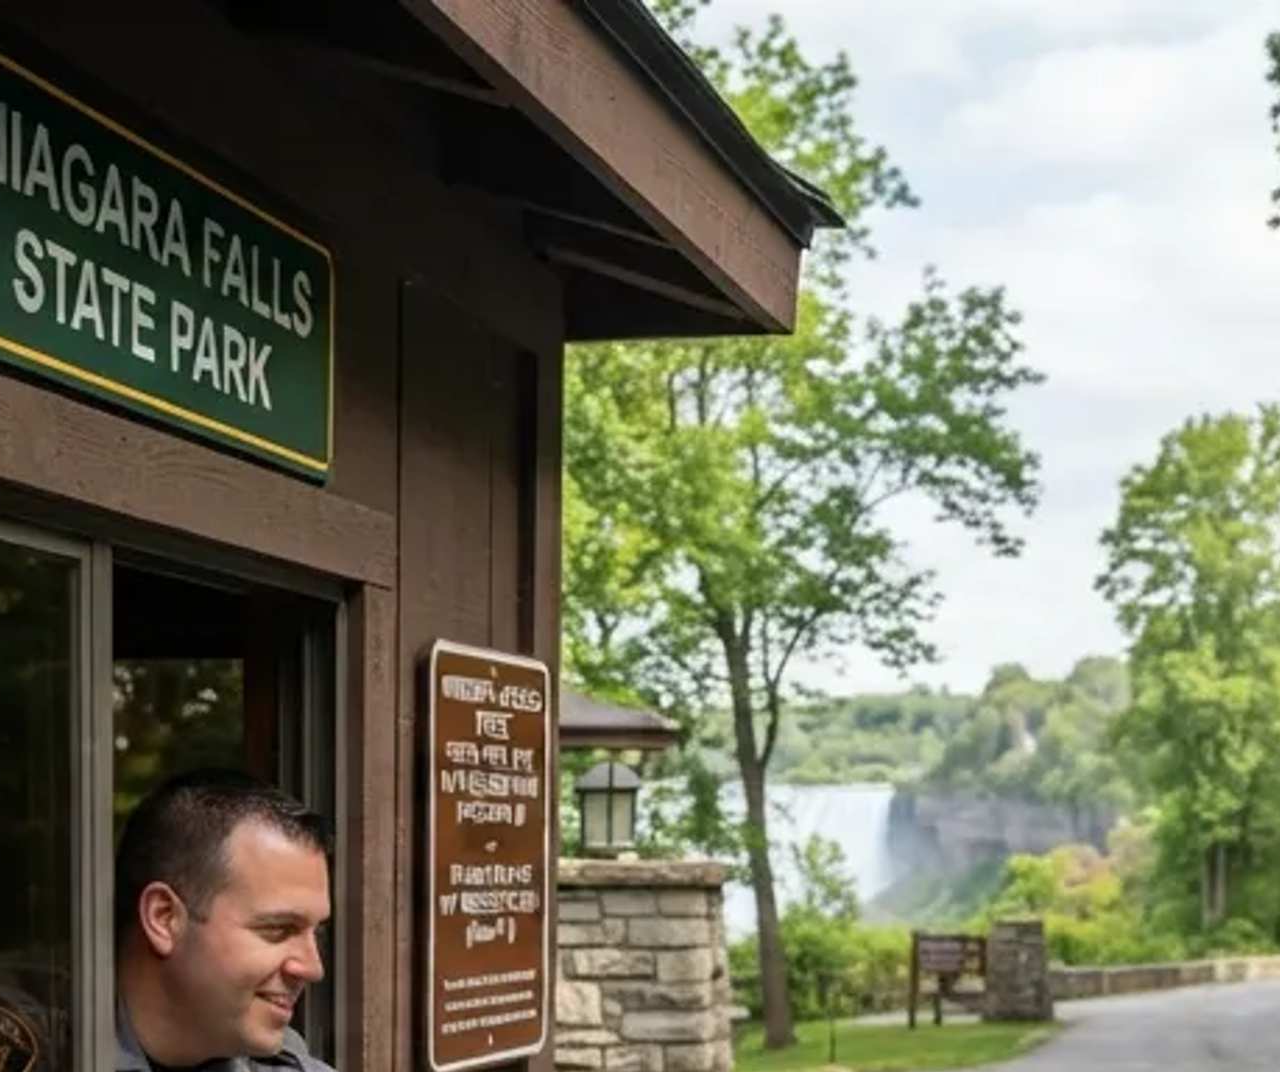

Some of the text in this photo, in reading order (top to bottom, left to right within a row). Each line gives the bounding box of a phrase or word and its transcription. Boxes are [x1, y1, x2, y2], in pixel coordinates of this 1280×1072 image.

[12, 229, 273, 411] STATE PARK
[203, 216, 314, 338] FALLS
